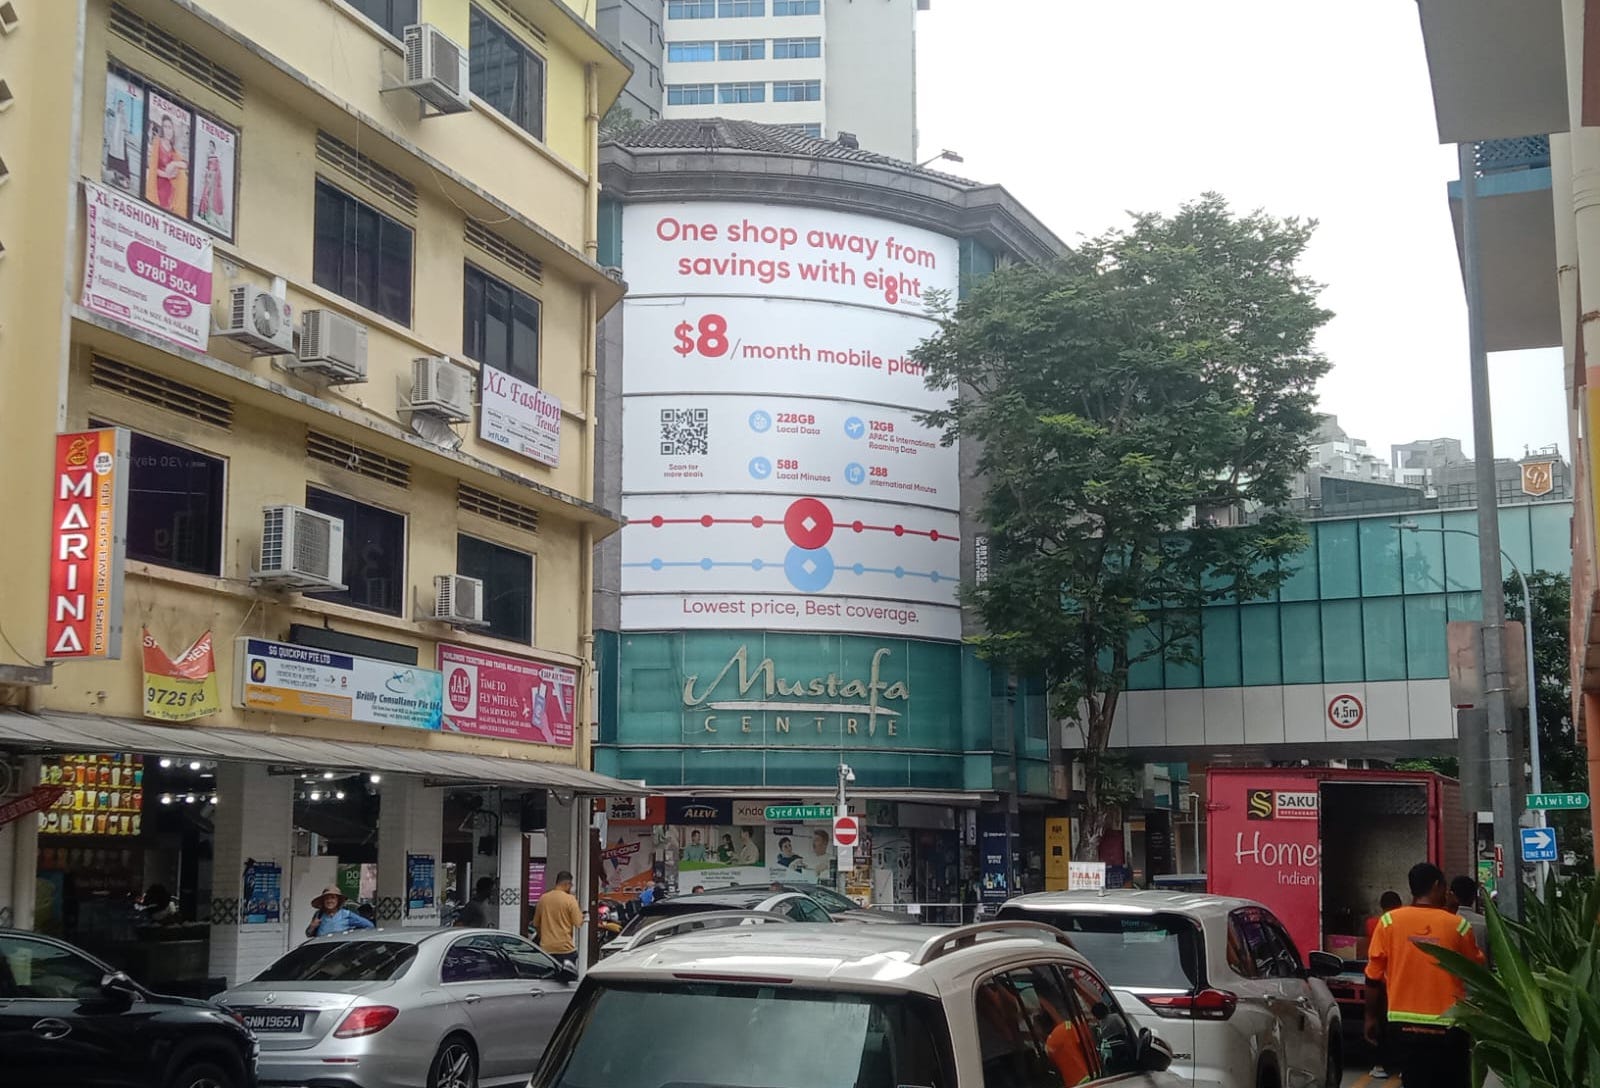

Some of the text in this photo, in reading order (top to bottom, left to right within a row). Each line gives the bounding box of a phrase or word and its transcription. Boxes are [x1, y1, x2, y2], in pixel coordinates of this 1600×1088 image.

[152, 95, 188, 122] FASHION
[200, 119, 230, 144] TRENDS
[95, 191, 202, 250] XL FASHION TRENDS
[656, 217, 936, 270] One shop away from
[159, 254, 178, 272] HP
[678, 252, 790, 284] savings
[797, 259, 856, 286] with
[136, 260, 198, 296] 9780 5034
[673, 313, 730, 358] $8
[817, 348, 883, 370] mobile
[484, 370, 506, 398] XL
[510, 382, 560, 422] Fashion
[536, 414, 560, 436] Trends
[776, 413, 816, 425] 228GB
[869, 420, 894, 432] 12GB
[776, 426, 820, 435] Local Data
[868, 432, 888, 442] APAC
[868, 441, 917, 454] Roaming Data
[776, 459, 798, 470] 588
[869, 466, 888, 478] 288
[776, 472, 831, 482] Local Minutes
[870, 480, 913, 490] International
[53, 471, 93, 654] MARINA
[682, 598, 920, 626] Lowest price, Best coverage.
[279, 647, 308, 660] QUICKPAY
[451, 675, 469, 694] JAP
[480, 678, 506, 692] TIME TO
[682, 644, 911, 736] Mustafa
[148, 688, 187, 706] 9725
[380, 694, 417, 709] Consultancy
[480, 692, 491, 704] FLY
[492, 693, 508, 706] WITH
[1334, 706, 1358, 718] 4.5m
[704, 716, 898, 736] CENTRE
[1536, 796, 1562, 805] Alwi
[1567, 796, 1582, 804] Rd
[770, 808, 792, 818] Syed
[795, 808, 817, 817] Alwi
[820, 807, 831, 816] Rd
[1236, 831, 1318, 866] Home
[1278, 870, 1315, 885] Indian
